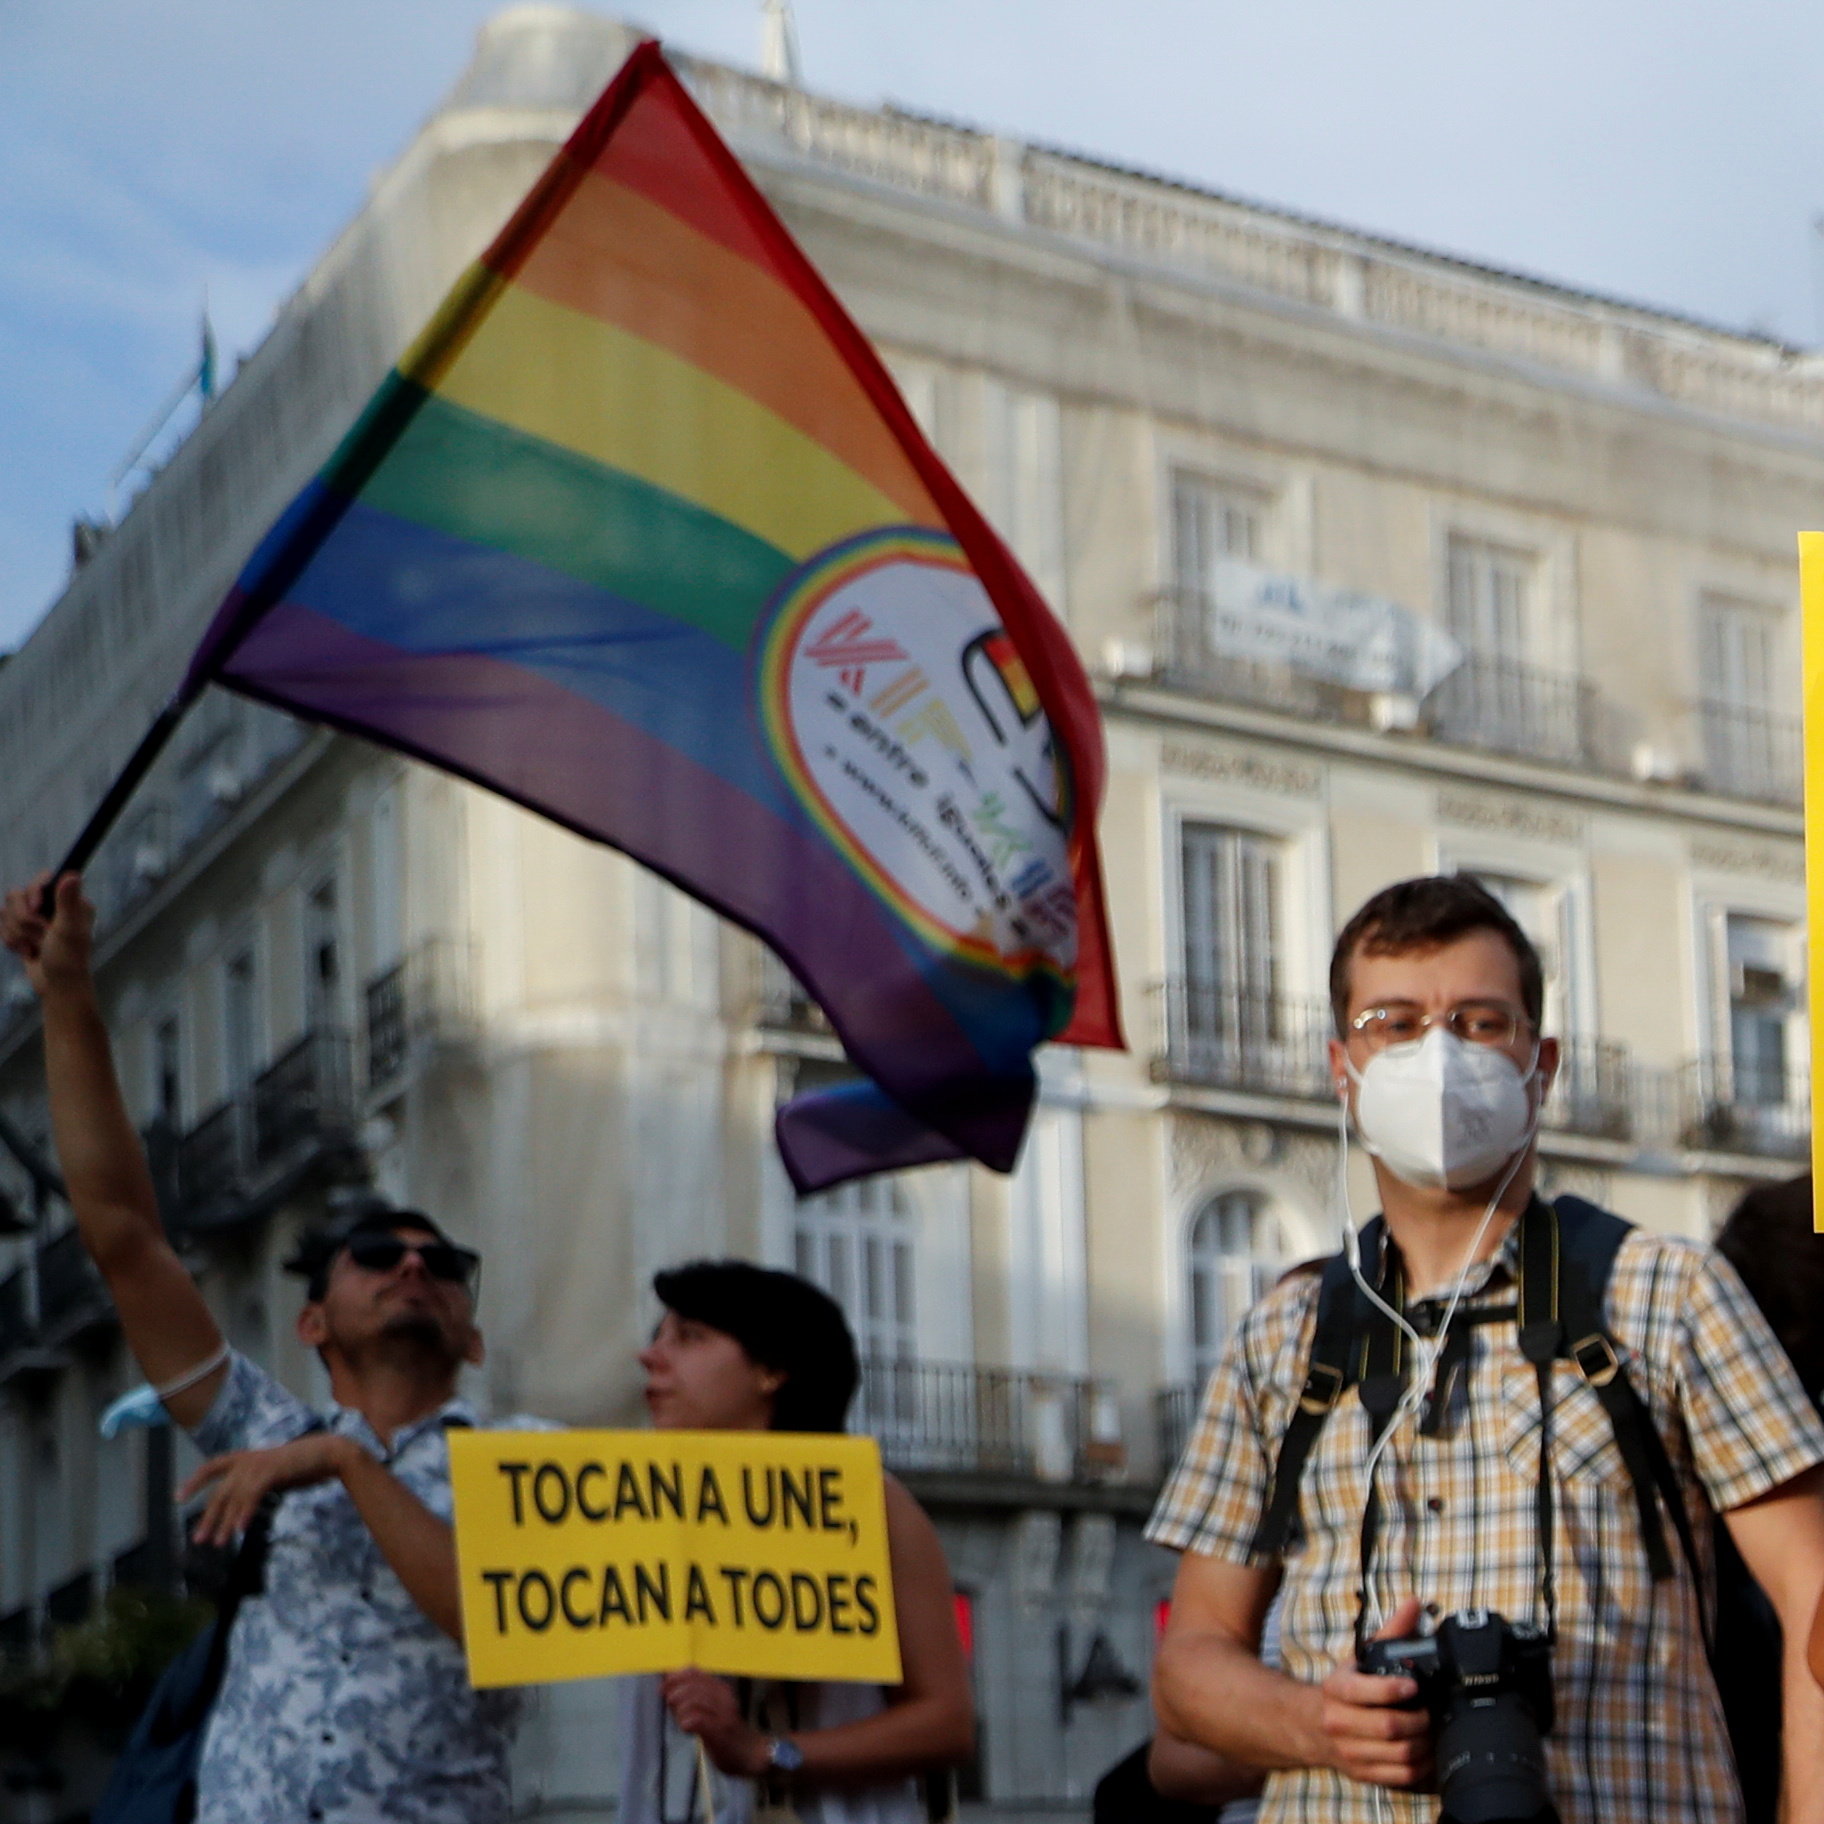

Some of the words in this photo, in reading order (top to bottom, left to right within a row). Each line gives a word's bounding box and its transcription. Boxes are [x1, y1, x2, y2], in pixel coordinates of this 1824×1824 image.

[497, 1461, 687, 1527] TOCAN
[695, 1465, 730, 1527] A
[741, 1466, 860, 1548] UNE,
[481, 1561, 673, 1636] TOCAN
[684, 1561, 717, 1627] A
[719, 1566, 881, 1638] TODES
